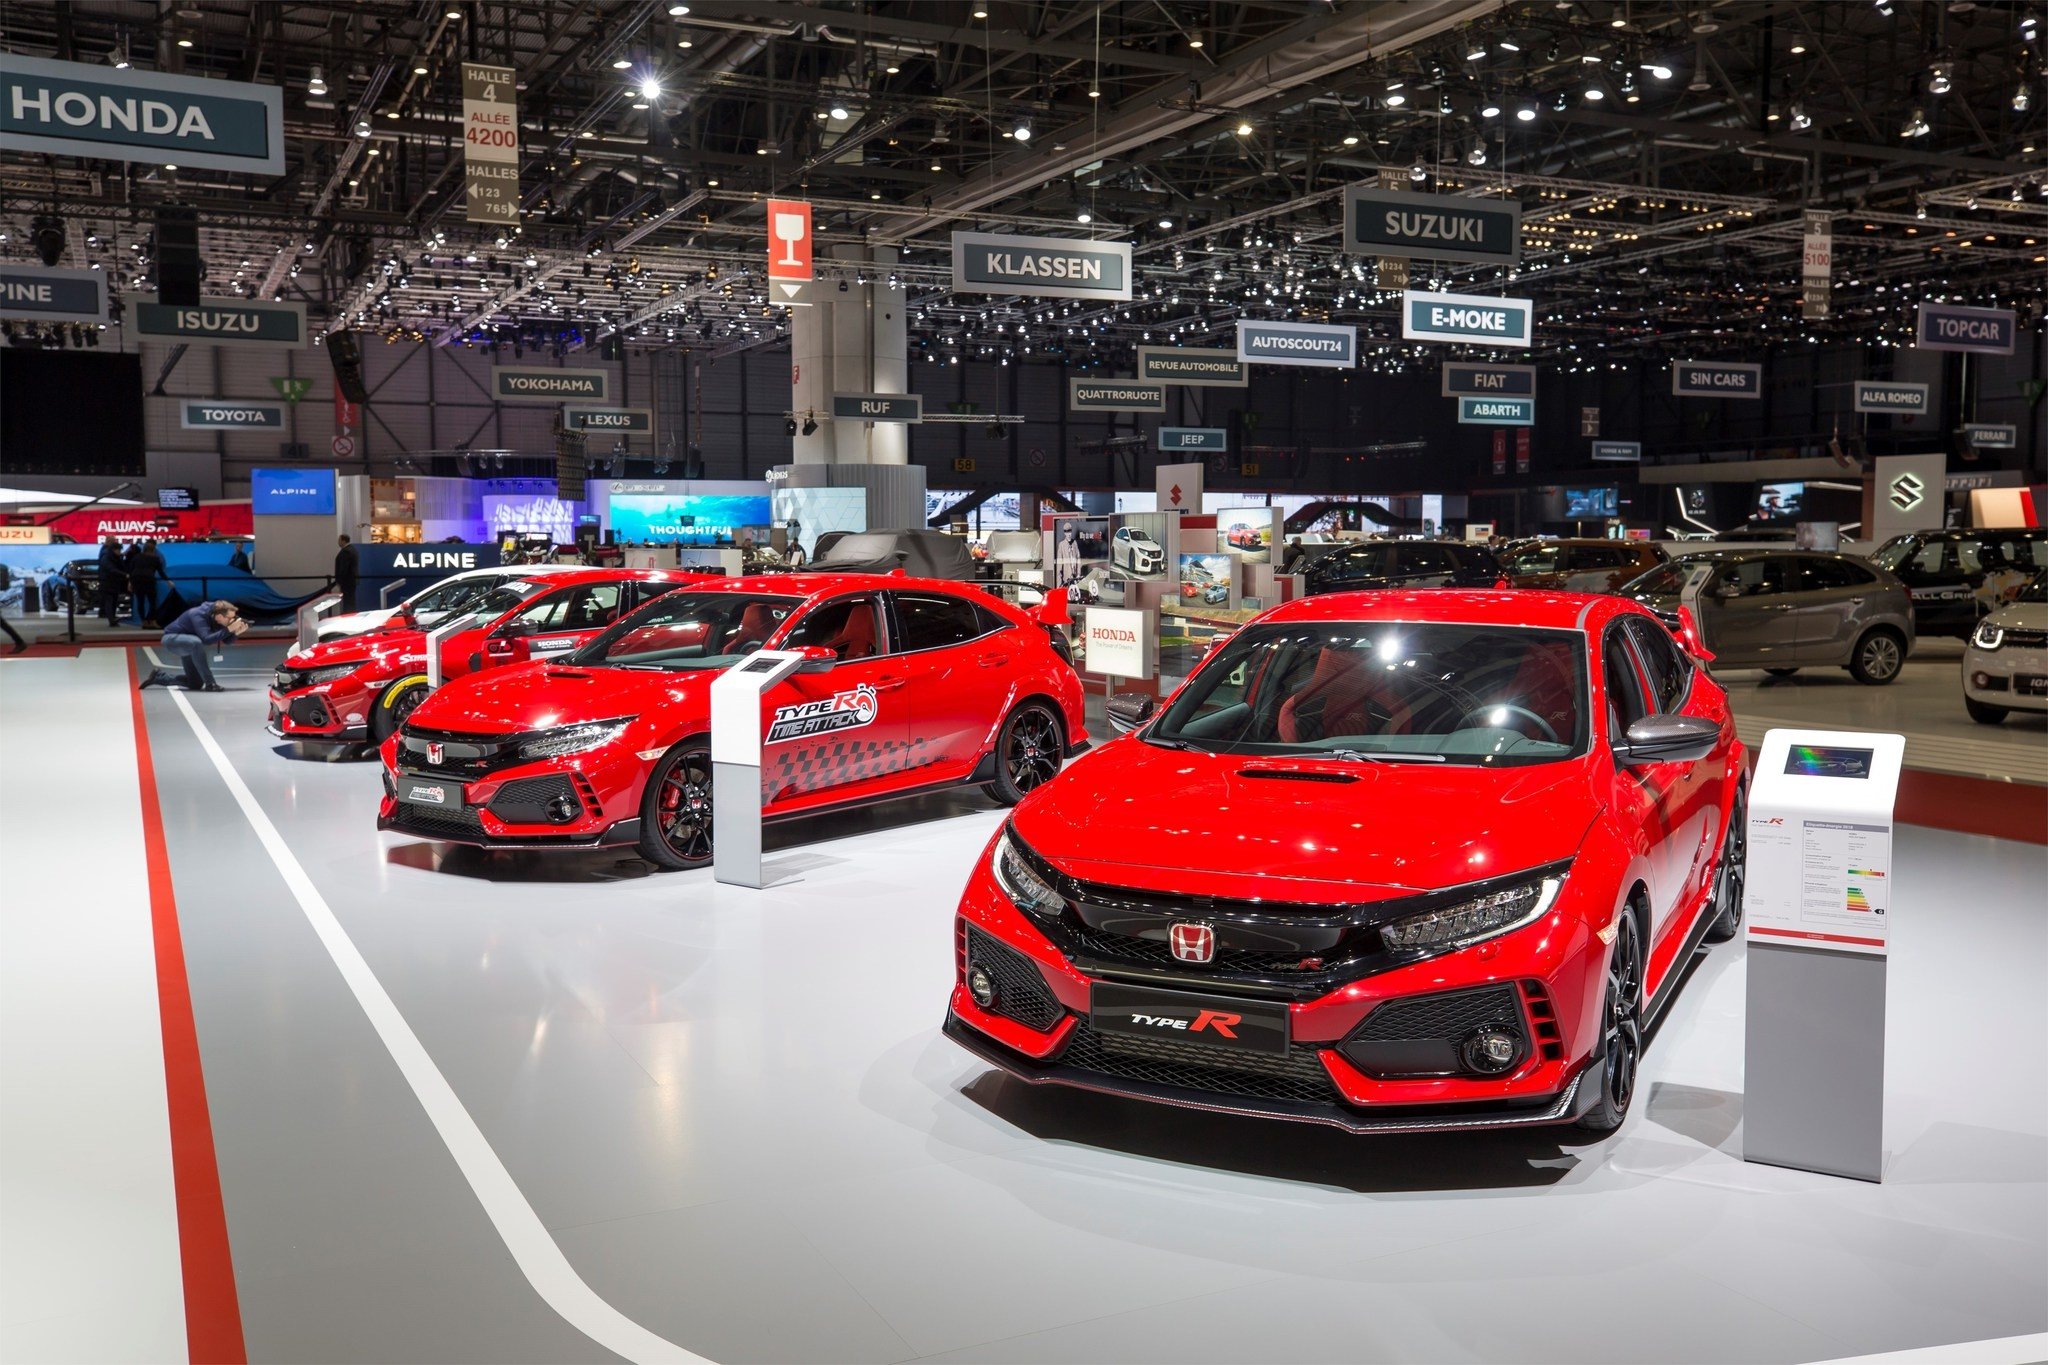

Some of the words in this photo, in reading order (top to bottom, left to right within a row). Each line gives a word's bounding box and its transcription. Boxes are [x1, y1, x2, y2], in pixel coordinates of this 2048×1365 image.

[468, 69, 511, 84] HALLE
[483, 84, 497, 102] 4
[12, 86, 215, 140] HONDA
[471, 112, 511, 125] ALLÉE
[466, 127, 517, 148] 4200
[466, 164, 519, 180] HALLES
[1381, 171, 1408, 182] HALLE
[479, 187, 500, 198] 123
[485, 203, 508, 214] 765
[1807, 213, 1829, 222] HALLE
[1385, 211, 1484, 242] SUZUKI
[1814, 223, 1822, 235] 5
[1384, 262, 1403, 270] 1234
[1804, 253, 1830, 266] 5100
[987, 253, 1101, 280] KLASSEN
[177, 311, 259, 332] ISUZU
[1431, 307, 1506, 331] E-MOKE
[1937, 318, 2000, 340] TOPCAR
[1252, 335, 1342, 352] AUTOSCOUT24
[1149, 361, 1179, 371] REVUE
[1180, 361, 1239, 373] AUTOMOBILE
[508, 378, 594, 391] YOKOHAMA
[1474, 374, 1507, 388] FIAT
[1690, 372, 1711, 385] SIN
[1714, 373, 1746, 387] CARS
[1077, 389, 1160, 401] QUATTRORUOTE
[1862, 392, 1887, 402] ALFA
[1888, 392, 1922, 404] ROMEO
[861, 401, 891, 414] RUF
[1473, 405, 1521, 416] ABARTH
[202, 409, 266, 422] TOYOTA
[587, 414, 631, 426] LEXUS
[1181, 434, 1204, 446] JEEP
[1974, 431, 2007, 441] FERRARI
[957, 459, 972, 471] 58
[98, 520, 156, 533] ALWAYS
[649, 525, 733, 535] THOUGHTFUL
[393, 552, 476, 568] ALPINE
[1092, 627, 1137, 642] HONDA
[537, 639, 573, 647] HONDA
[777, 701, 832, 719] TYPE
[833, 693, 857, 711] R
[773, 722, 803, 740] TIME
[802, 711, 860, 734] ATTACK
[1131, 1013, 1188, 1029] TYPE
[1189, 1009, 1242, 1039] R
